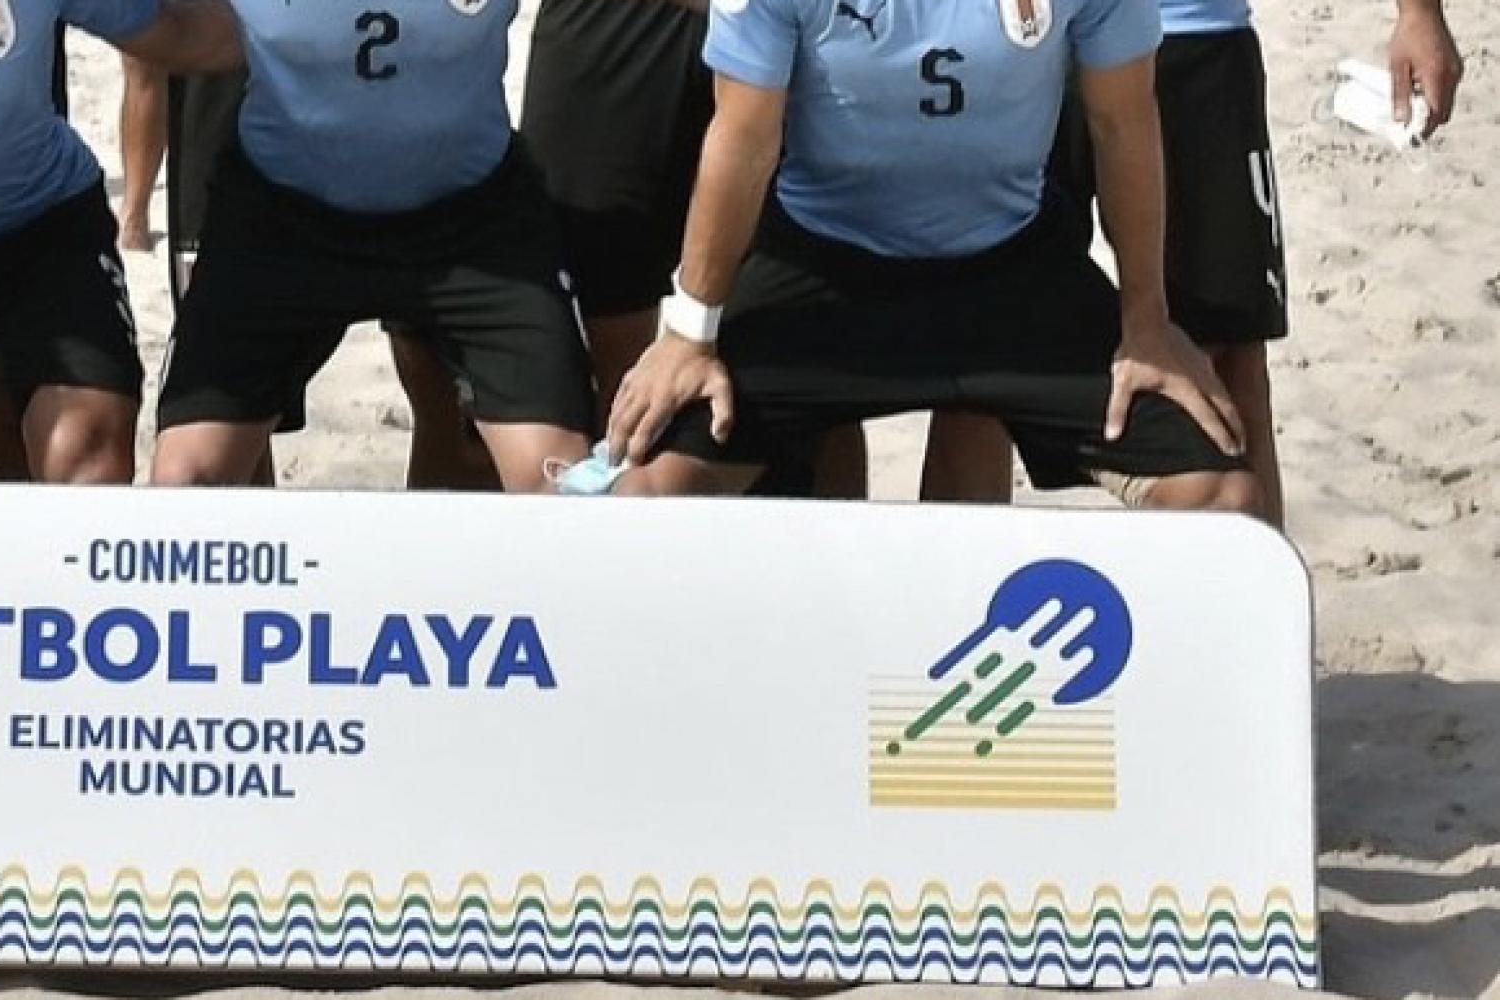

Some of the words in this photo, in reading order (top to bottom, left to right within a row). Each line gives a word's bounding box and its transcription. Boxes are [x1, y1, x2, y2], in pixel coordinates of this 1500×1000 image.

[354, 11, 401, 83] 2
[918, 47, 966, 119] 5
[242, 609, 558, 690] PLAYA
[9, 713, 367, 756] ELIMINATORIAS
[80, 759, 295, 798] MUNDIAL
